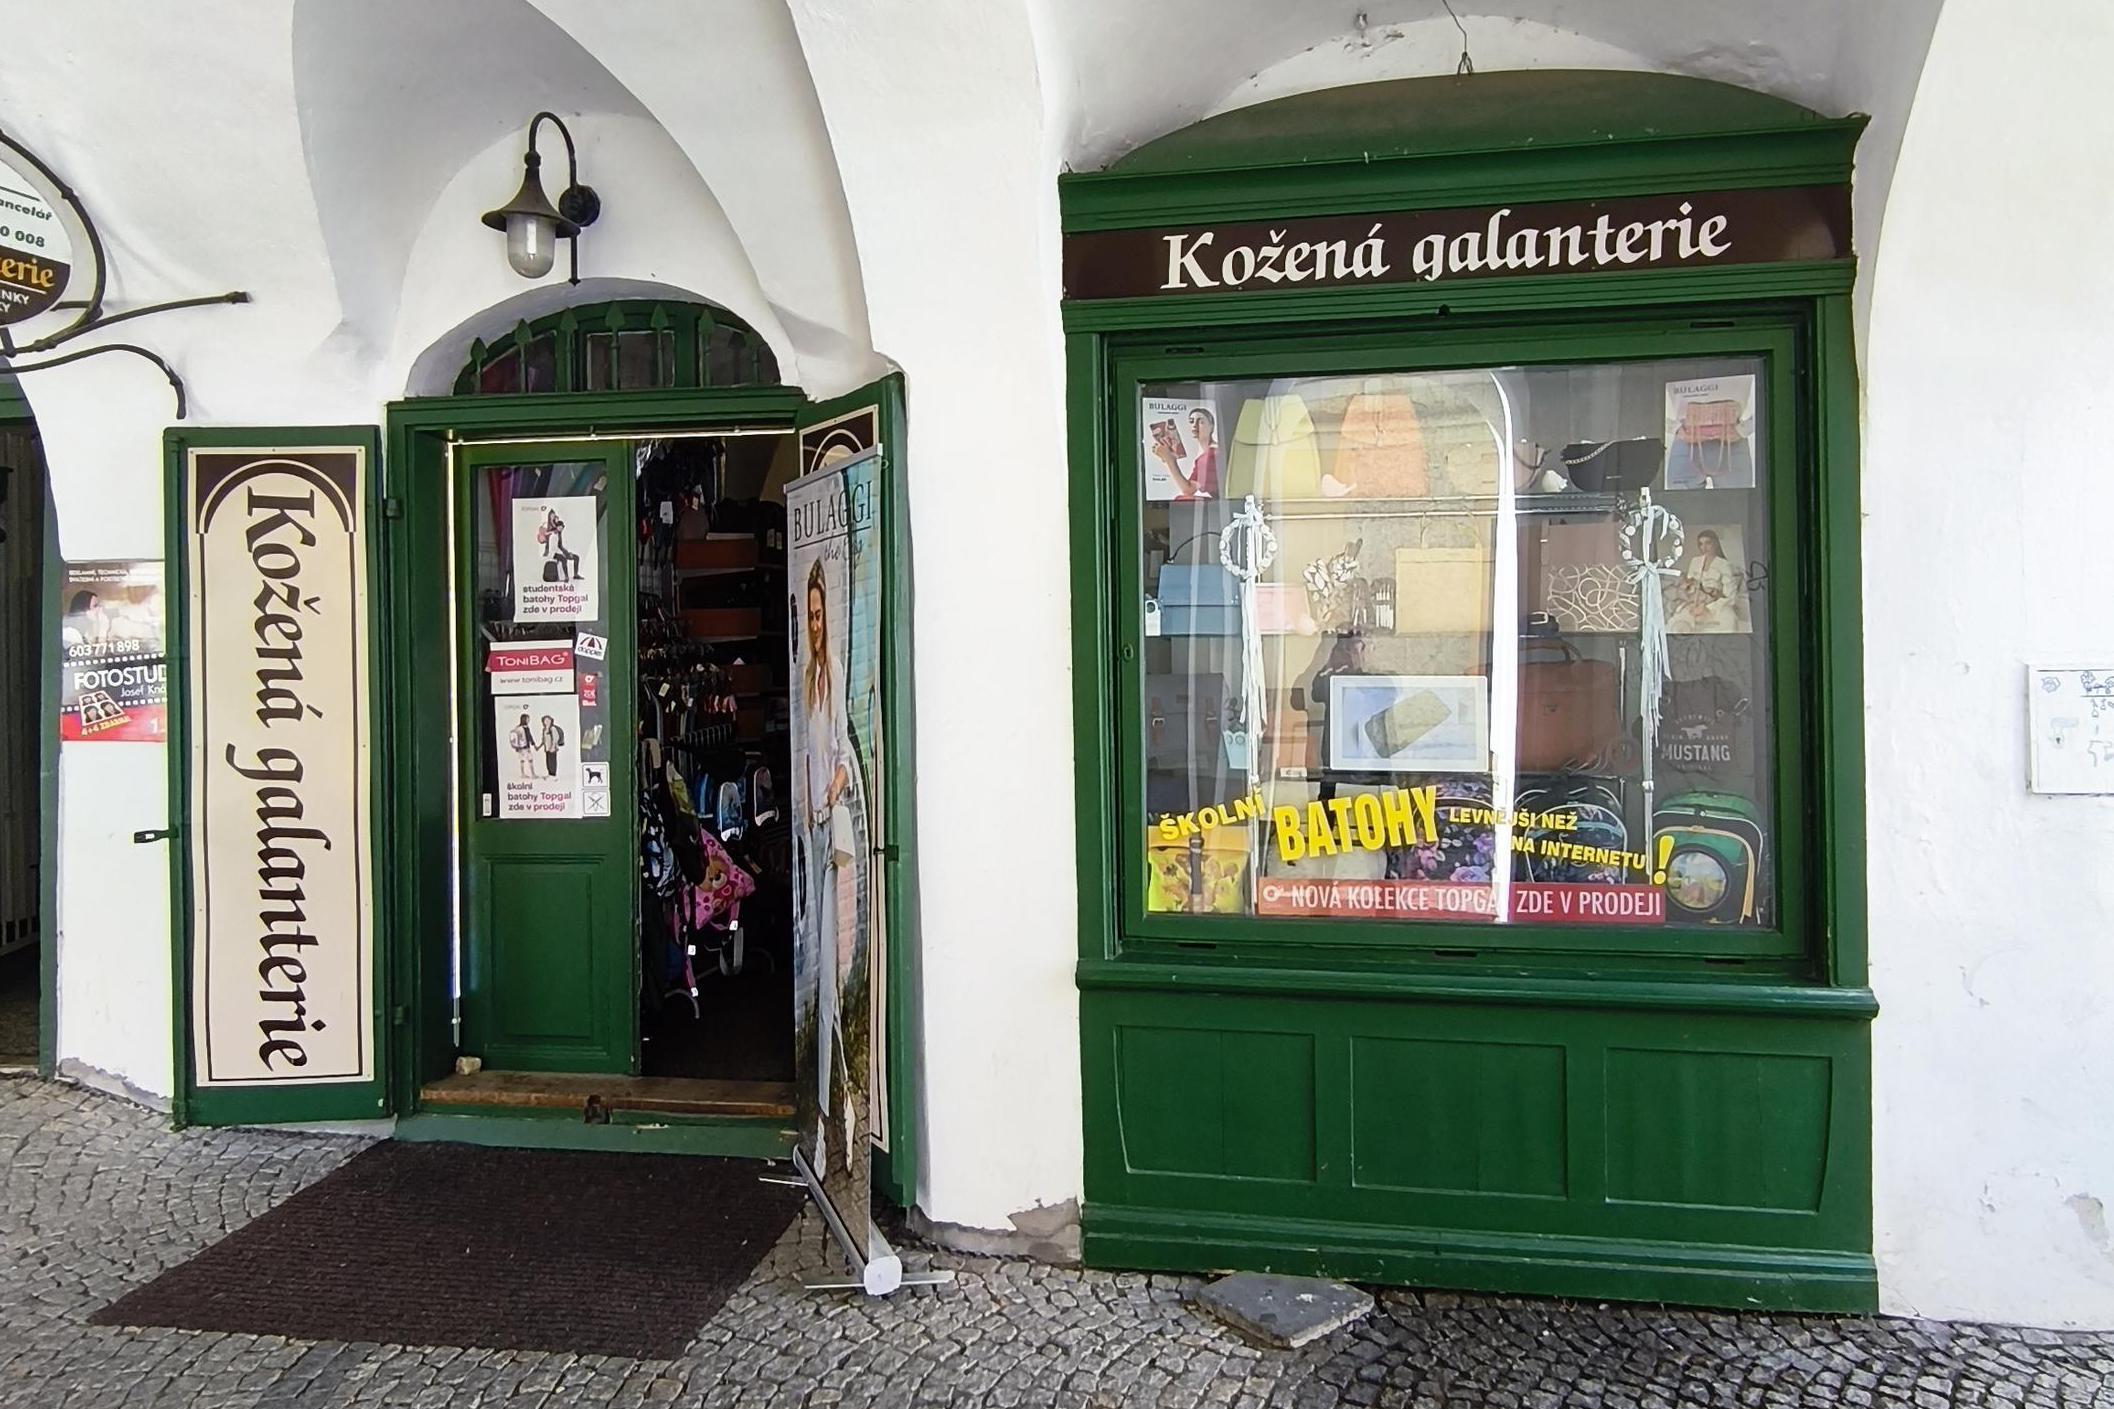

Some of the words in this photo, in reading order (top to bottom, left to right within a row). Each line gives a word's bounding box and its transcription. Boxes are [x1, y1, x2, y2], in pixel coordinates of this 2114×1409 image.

[15, 231, 45, 248] 008
[1160, 222, 1390, 290] Kožená
[1412, 201, 1732, 282] galanterie
[0, 257, 56, 288] erie
[794, 479, 872, 542] BULAGGI
[523, 584, 575, 593] studentské
[246, 485, 323, 729] Kožená
[523, 595, 555, 605] batohy
[558, 594, 588, 604] Topgal
[523, 605, 540, 614] zde
[550, 605, 582, 614] prodeji
[69, 644, 92, 657] 603
[92, 642, 115, 657] 771
[117, 640, 140, 653] 898
[121, 684, 144, 698] Josef
[1661, 744, 1731, 761] MUSTANG
[507, 782, 533, 790] školní
[507, 792, 538, 802] batohy
[540, 791, 572, 802] Topgal
[508, 802, 525, 811] zde
[1273, 784, 1439, 862] BATOHY
[1541, 811, 1578, 831] NEŽ
[1511, 835, 1535, 854] NA
[1292, 880, 1341, 909] NOVÁ
[1348, 885, 1431, 911] KOLEKCE
[1436, 887, 1505, 914] TOPGA
[1516, 890, 1555, 914] ZDE
[1559, 890, 1573, 914] V
[1579, 890, 1661, 917] PRODEJI
[225, 743, 332, 1073] galanterie
